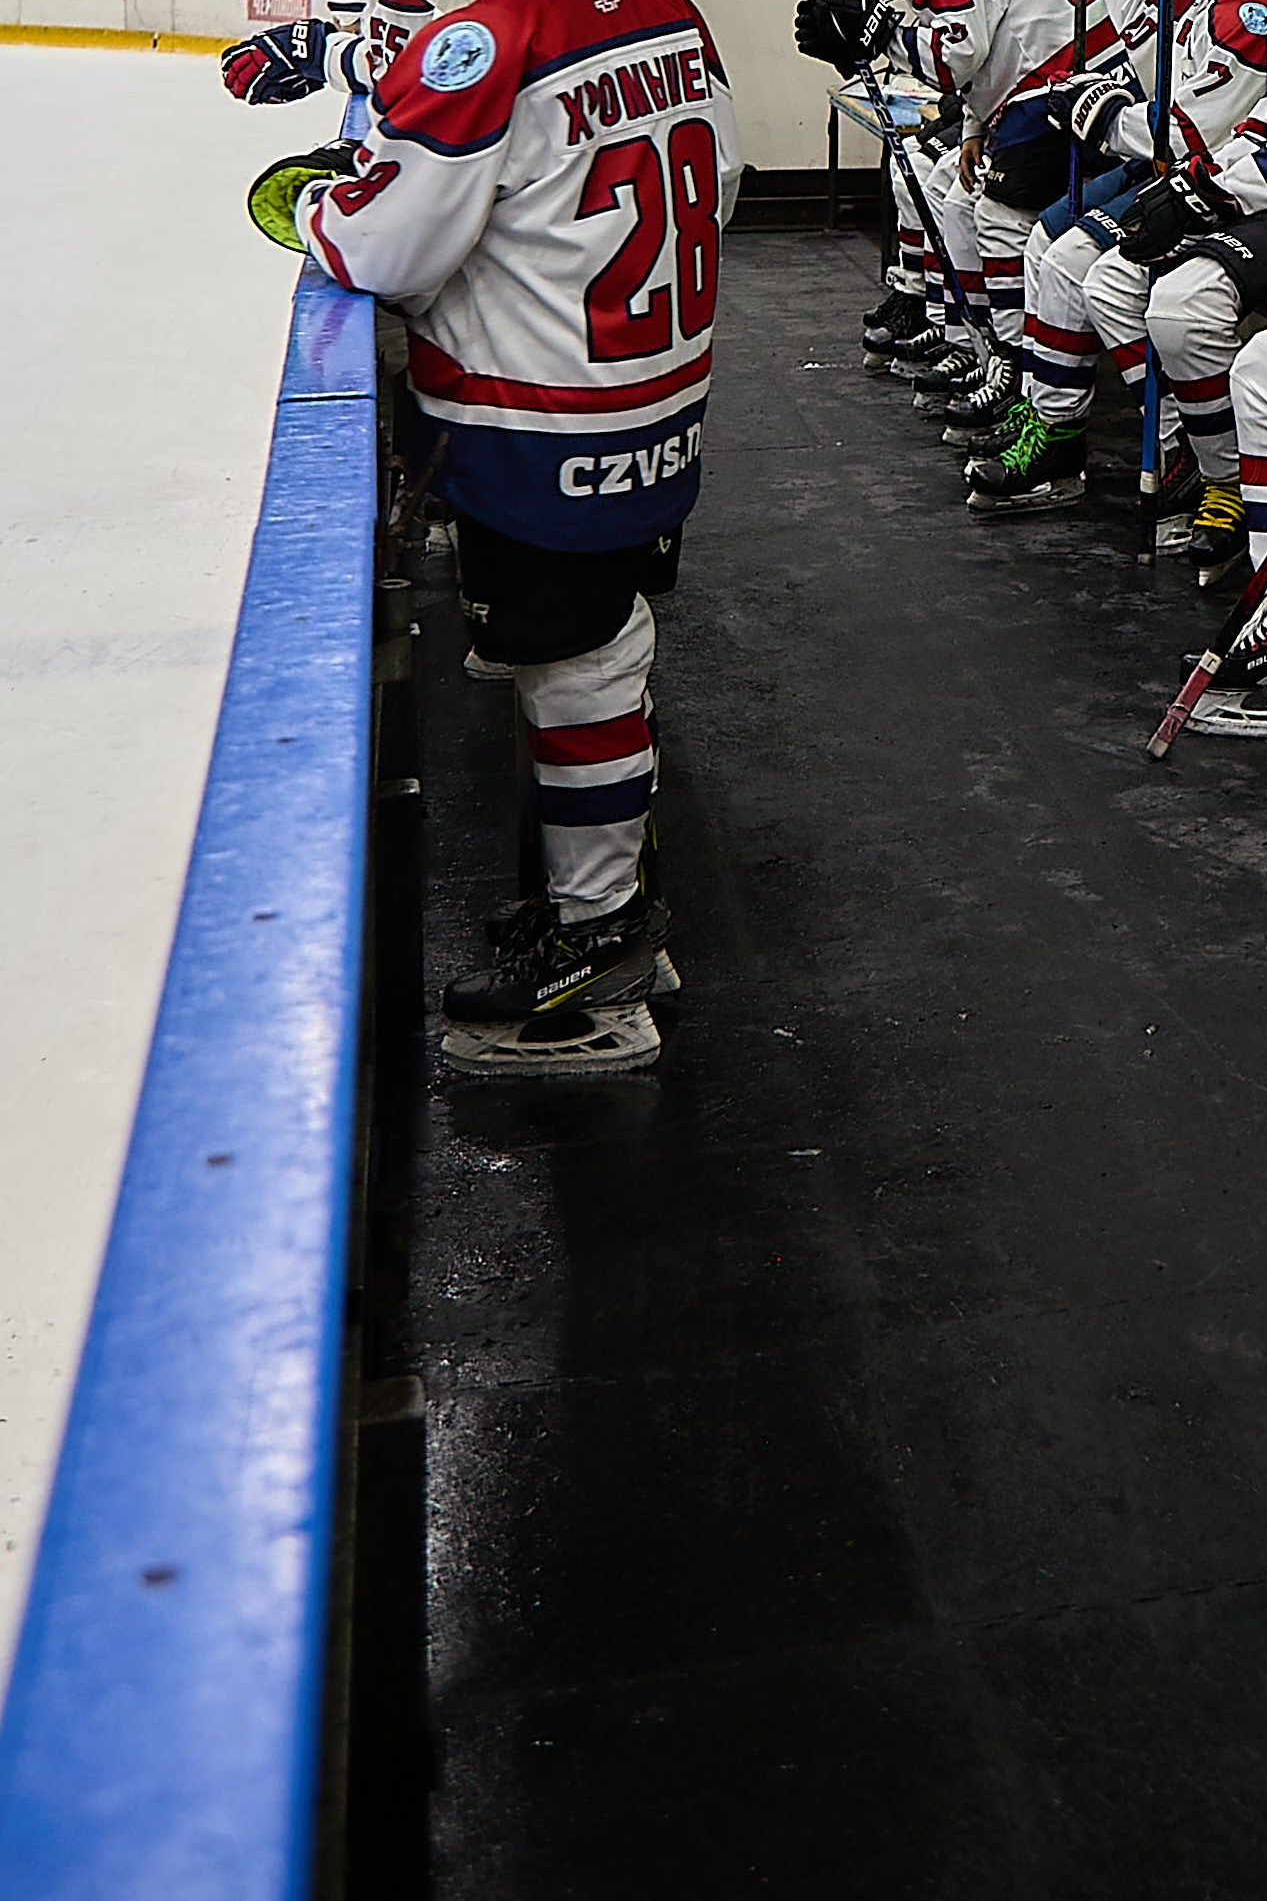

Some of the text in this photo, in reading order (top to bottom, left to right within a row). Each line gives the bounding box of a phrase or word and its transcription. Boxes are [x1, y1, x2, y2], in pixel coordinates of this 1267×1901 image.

[1192, 60, 1234, 98] 7
[574, 117, 720, 364] 28
[536, 965, 592, 1000] BAUER
